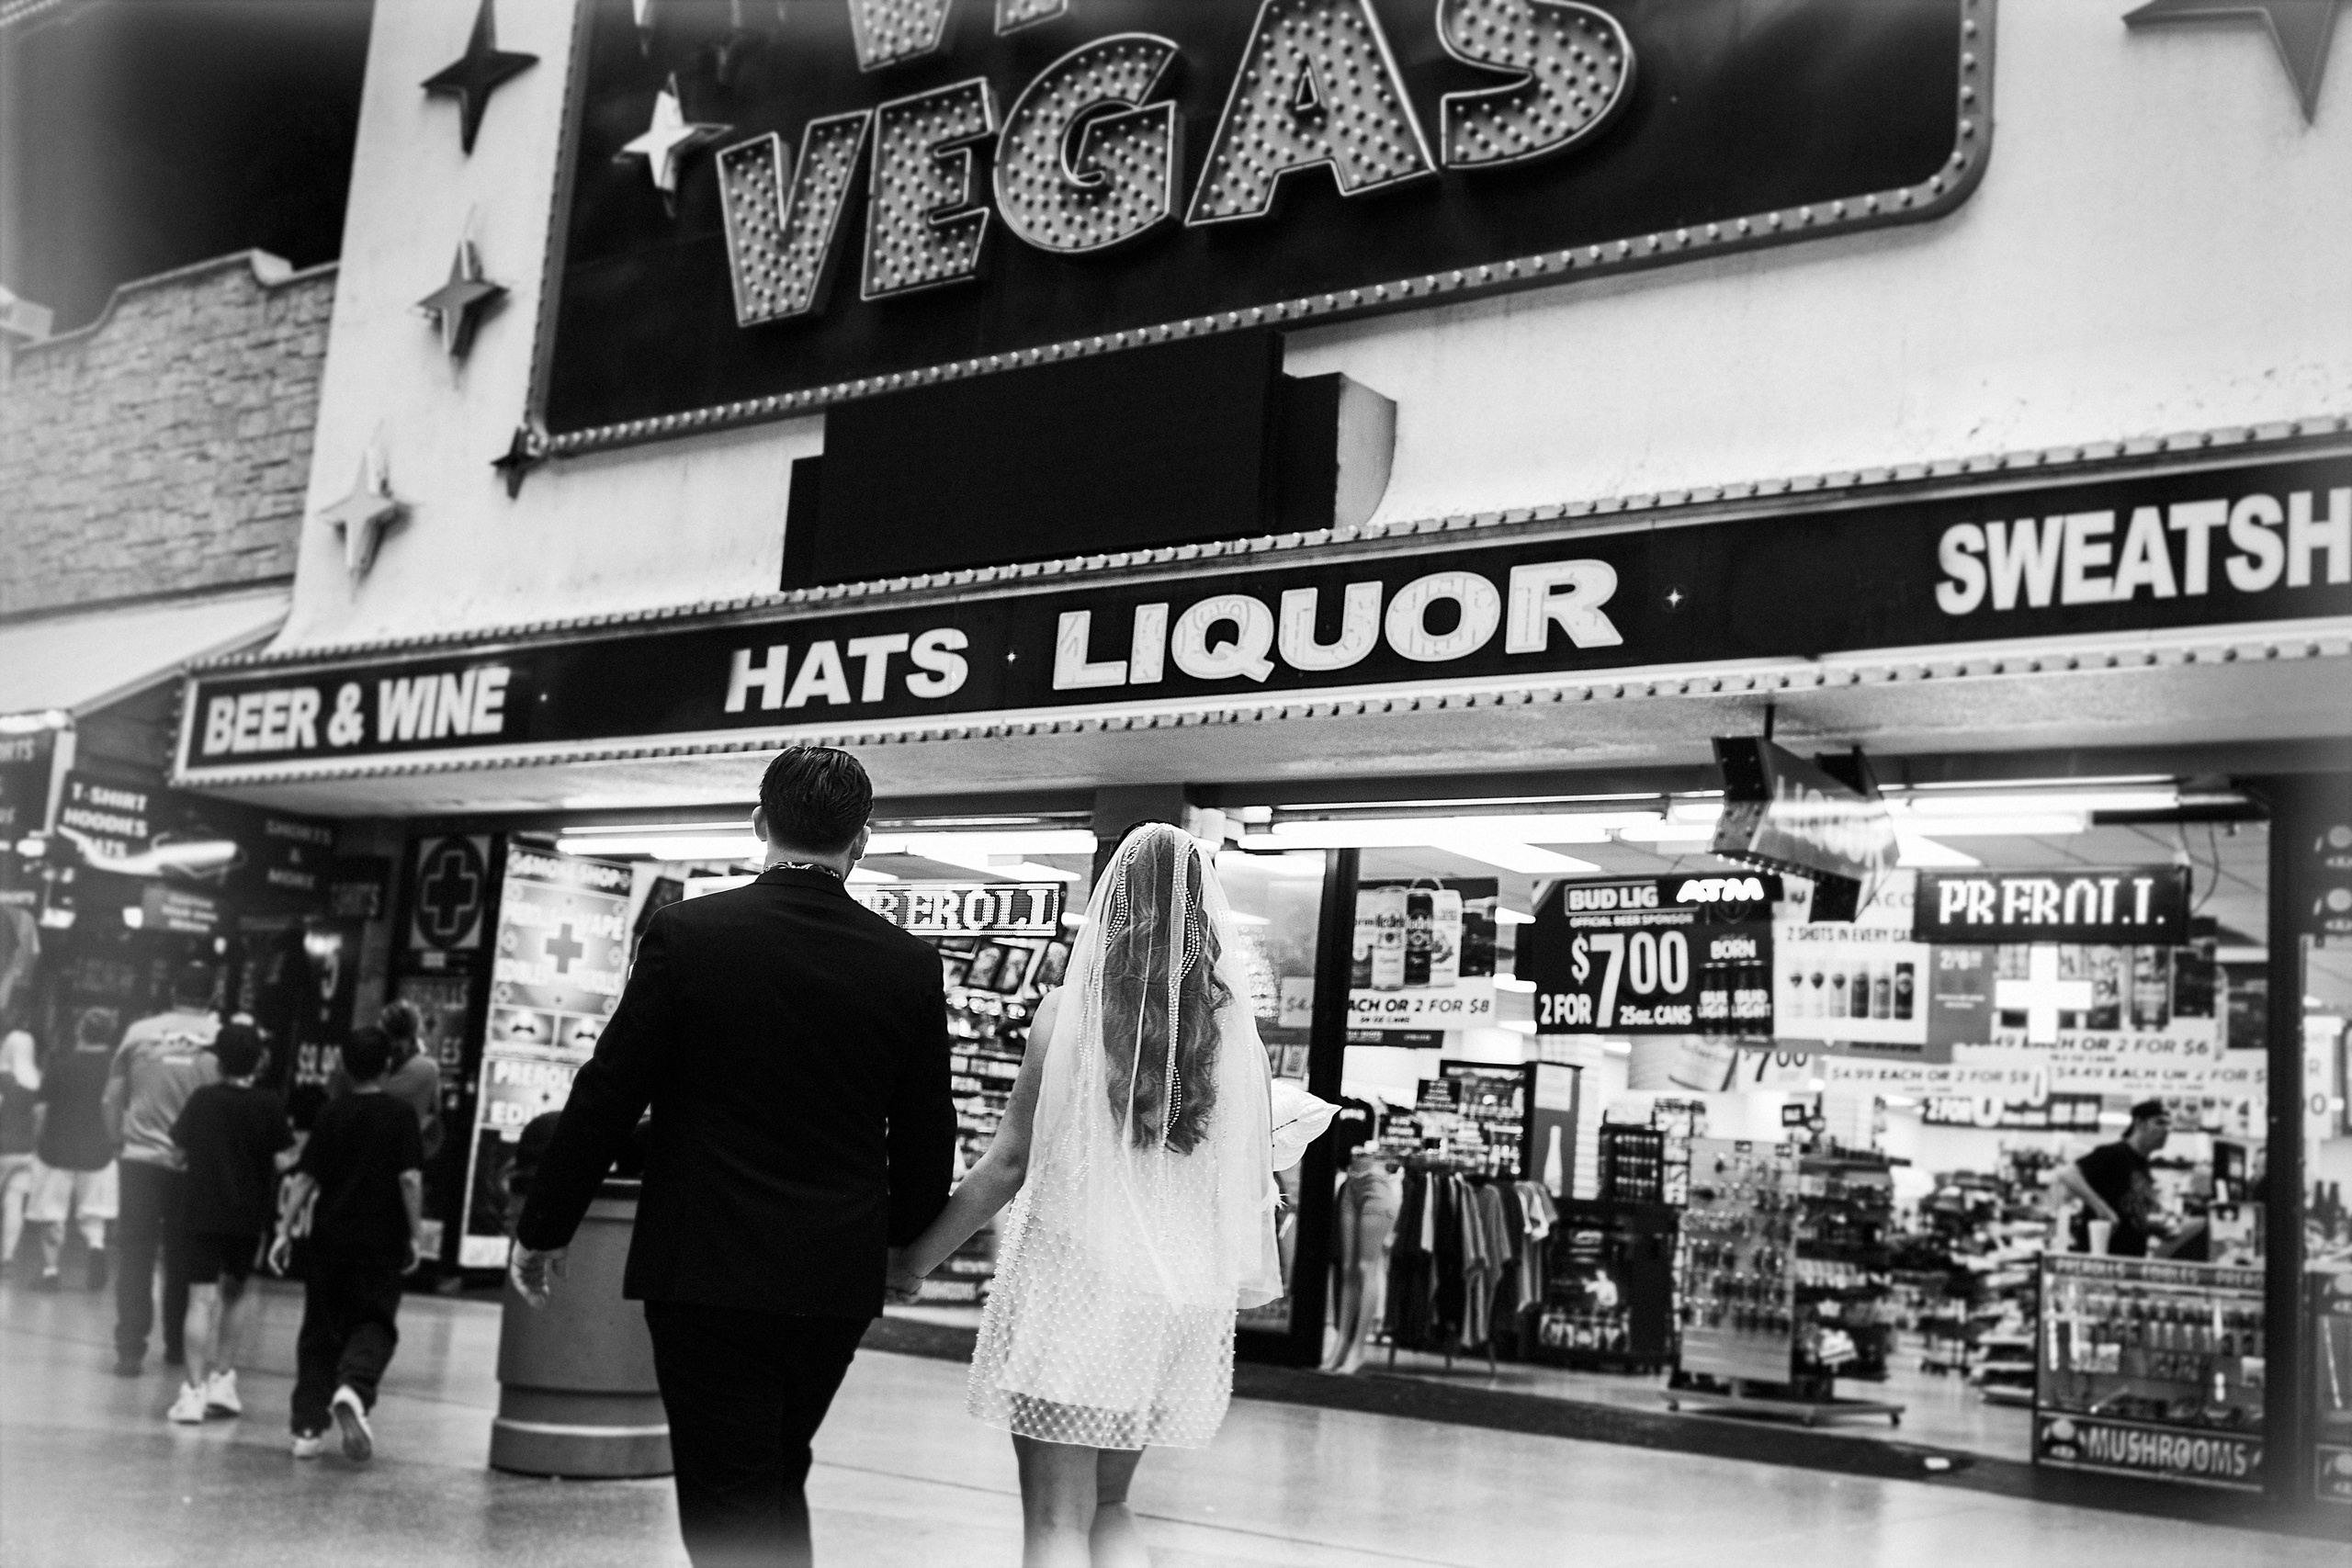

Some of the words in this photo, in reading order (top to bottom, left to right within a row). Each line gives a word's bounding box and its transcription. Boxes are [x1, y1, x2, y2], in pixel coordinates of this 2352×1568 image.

[717, 0, 1635, 326] VEGAS
[725, 627, 969, 713] HATS
[1053, 558, 1623, 690] LIQUOR
[202, 686, 319, 755] BEER
[326, 682, 364, 747] &
[378, 667, 511, 742] WINE
[1569, 887, 1618, 910] BUD
[1620, 886, 1658, 908] LIG
[1676, 877, 1765, 902] ATM
[1711, 939, 1756, 960] BORN
[1349, 998, 1380, 1011] ACH
[1385, 998, 1408, 1011] OR
[1415, 999, 1423, 1012] 2
[1429, 999, 1463, 1011] FOR
[1541, 994, 1552, 1025] 2
[1554, 994, 1591, 1025] FOR
[1655, 1004, 1692, 1025] CANS
[2082, 1037, 2109, 1051] OR
[2117, 1038, 2128, 1052] 2
[2134, 1038, 2177, 1053] FOR
[2088, 1427, 2246, 1476] MUSHROOMS
